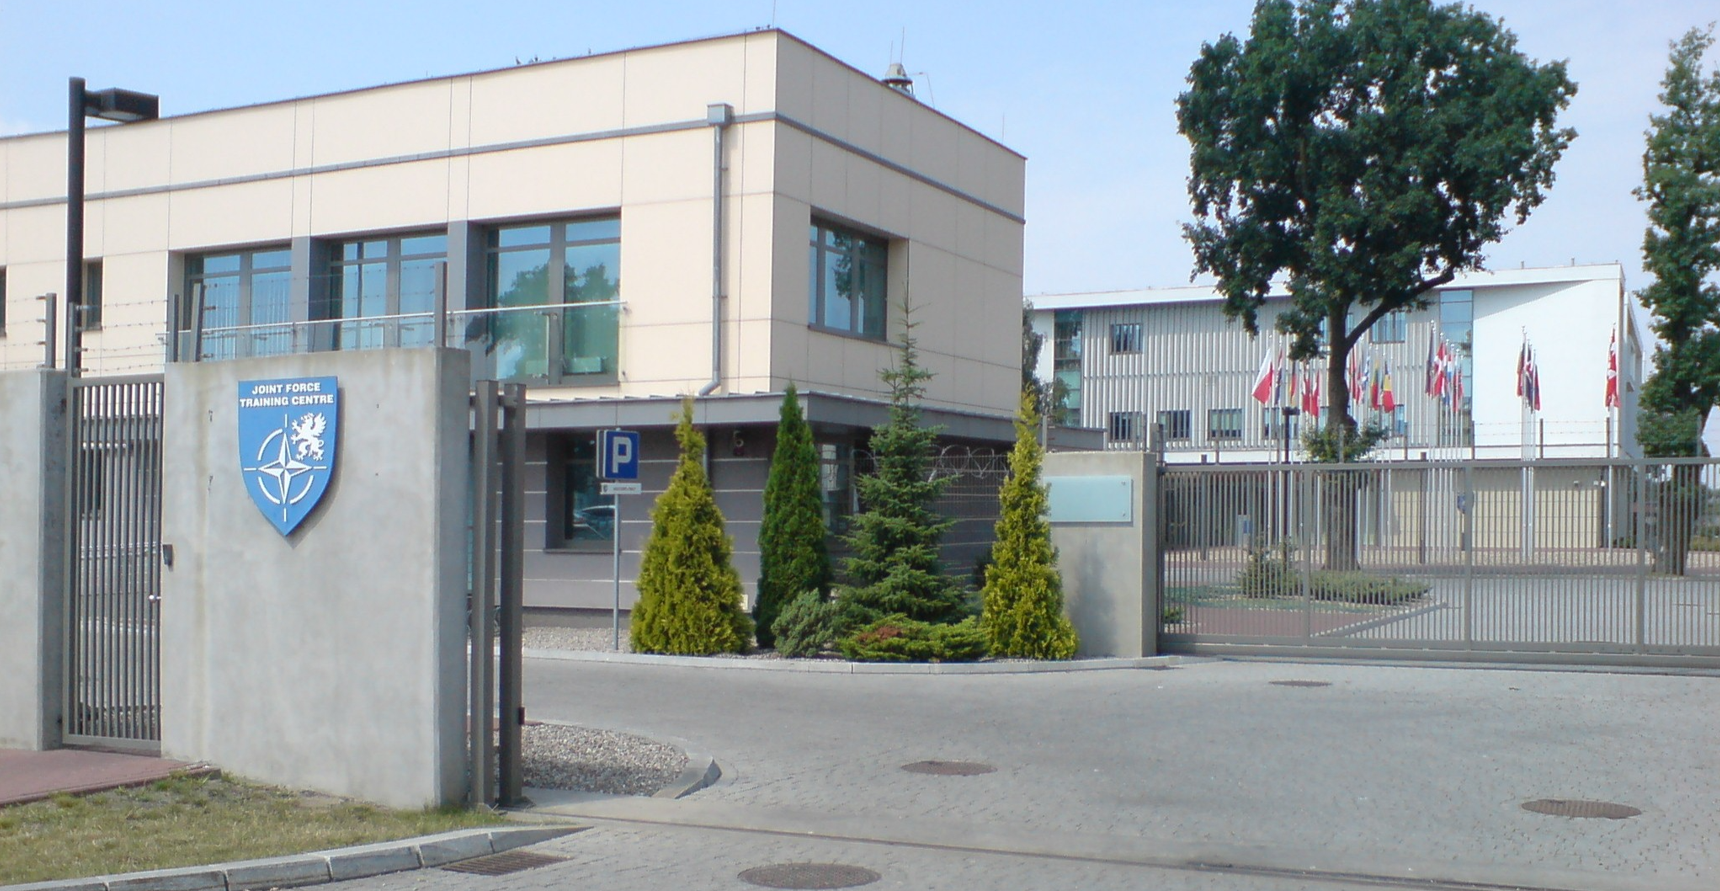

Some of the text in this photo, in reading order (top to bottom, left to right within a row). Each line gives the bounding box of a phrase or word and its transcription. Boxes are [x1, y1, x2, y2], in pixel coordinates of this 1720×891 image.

[252, 382, 321, 395] JOINT FORCE
[240, 394, 334, 408] TRAINING CENTRE
[612, 436, 632, 473] P
